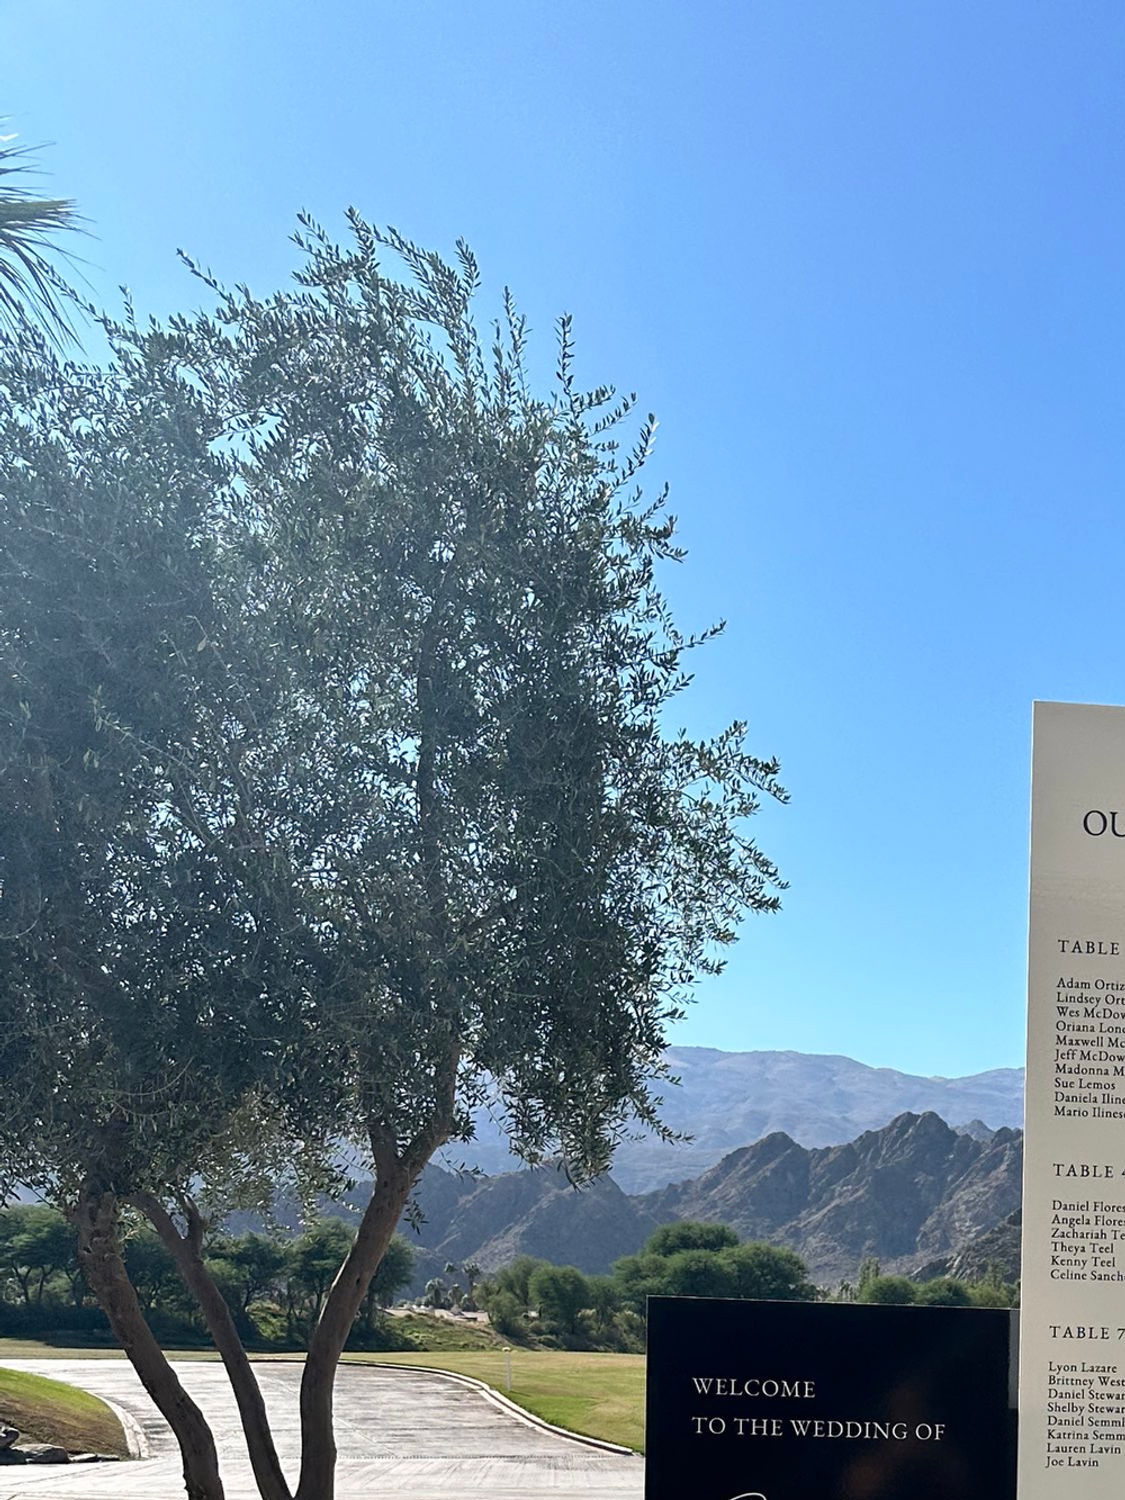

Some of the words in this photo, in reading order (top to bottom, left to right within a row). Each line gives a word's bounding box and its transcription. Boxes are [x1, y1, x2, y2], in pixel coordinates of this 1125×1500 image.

[1058, 939, 1120, 956] TABLE
[1056, 977, 1091, 990] Adam
[1094, 979, 1125, 991] Ortiz
[1057, 992, 1102, 1010] Lindsey
[1056, 1020, 1096, 1033] Oriana
[1055, 1063, 1110, 1076] Madonna
[1053, 1163, 1114, 1179] TABLE
[1052, 1200, 1090, 1212] Daniel
[1051, 1226, 1108, 1240] Zachariah
[1050, 1269, 1088, 1281] Celine
[1049, 1325, 1110, 1340] TABLE
[1117, 1328, 1125, 1340] 7
[1049, 1361, 1078, 1376] Lyon
[1081, 1362, 1117, 1374] Lazare
[692, 1377, 815, 1398] WELCOME
[1048, 1375, 1095, 1390] Brittney
[1098, 1376, 1125, 1387] West
[692, 1417, 725, 1434] TO
[734, 1418, 783, 1436] THE
[790, 1420, 907, 1439] WEDDING
[916, 1423, 945, 1440] OF
[1048, 1429, 1090, 1441] Katrina
